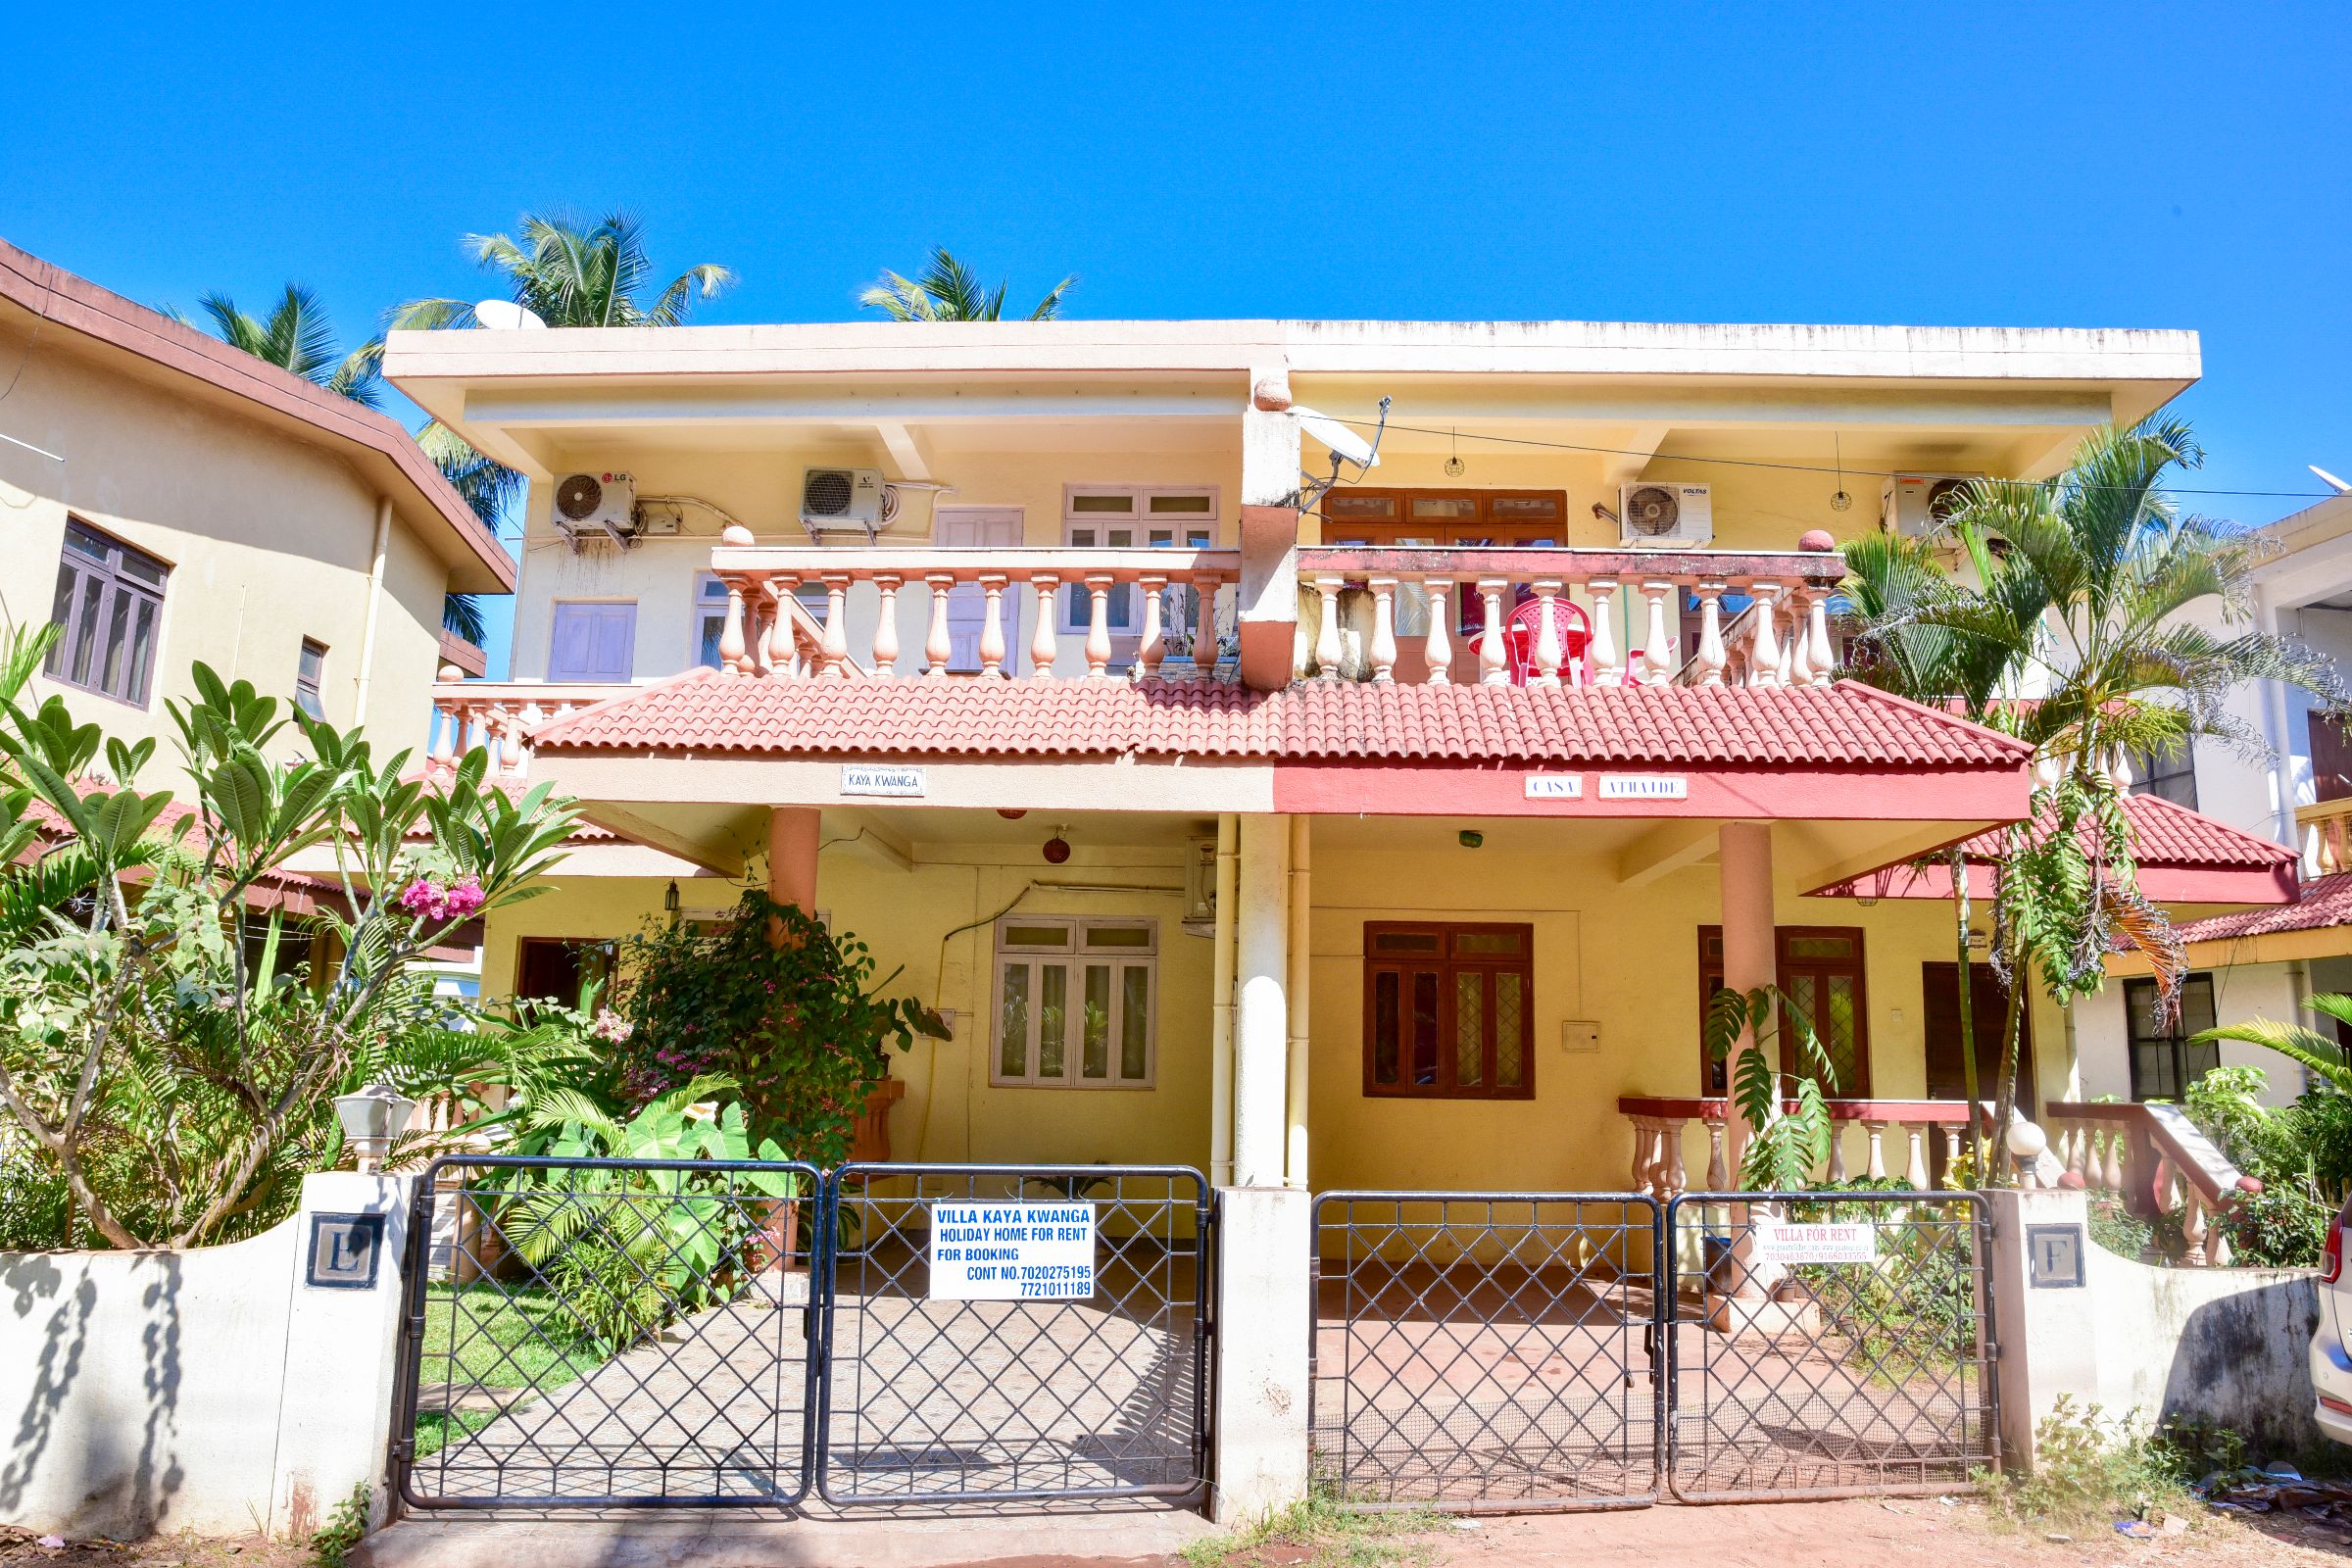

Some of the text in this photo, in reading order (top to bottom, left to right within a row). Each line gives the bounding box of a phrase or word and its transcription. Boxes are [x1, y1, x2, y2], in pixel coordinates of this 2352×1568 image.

[849, 773, 918, 787] KAYA KWANGA
[1533, 781, 1680, 793] CASA ATHAIDE
[937, 1208, 1090, 1224] VILLA KAYA KWANGA
[940, 1227, 1088, 1243] HOLIDAY HOME FOR RENT
[1774, 1228, 1857, 1242] VILLA FOR RENT
[327, 1231, 362, 1271] E
[937, 1248, 1019, 1261] FOR BOOKING
[2043, 1240, 2068, 1273] F
[967, 1266, 998, 1281] CONT
[1020, 1281, 1091, 1297] 7721011189
